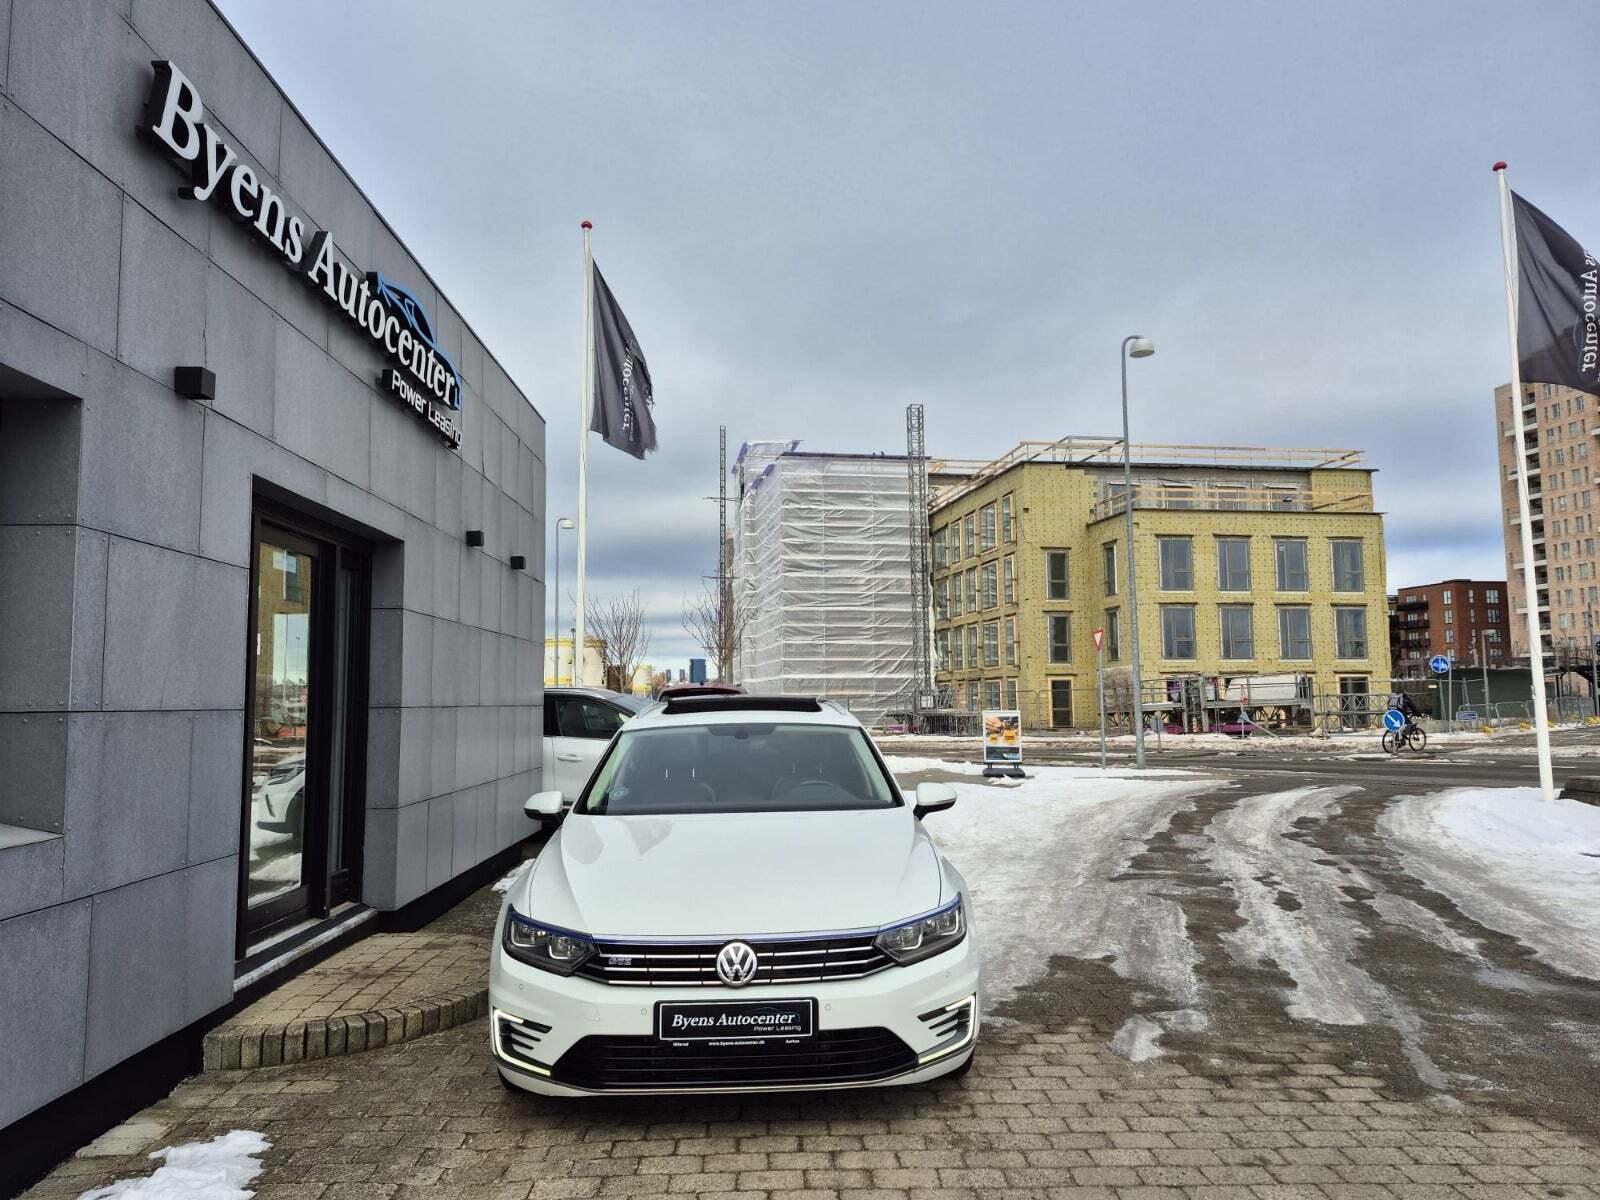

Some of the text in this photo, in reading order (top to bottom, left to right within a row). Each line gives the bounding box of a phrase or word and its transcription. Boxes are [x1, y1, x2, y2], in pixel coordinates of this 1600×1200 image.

[151, 60, 456, 406] Byens Autocenter
[391, 368, 462, 450] Power Leasing
[672, 1013, 796, 1030] Byens Autocenter
